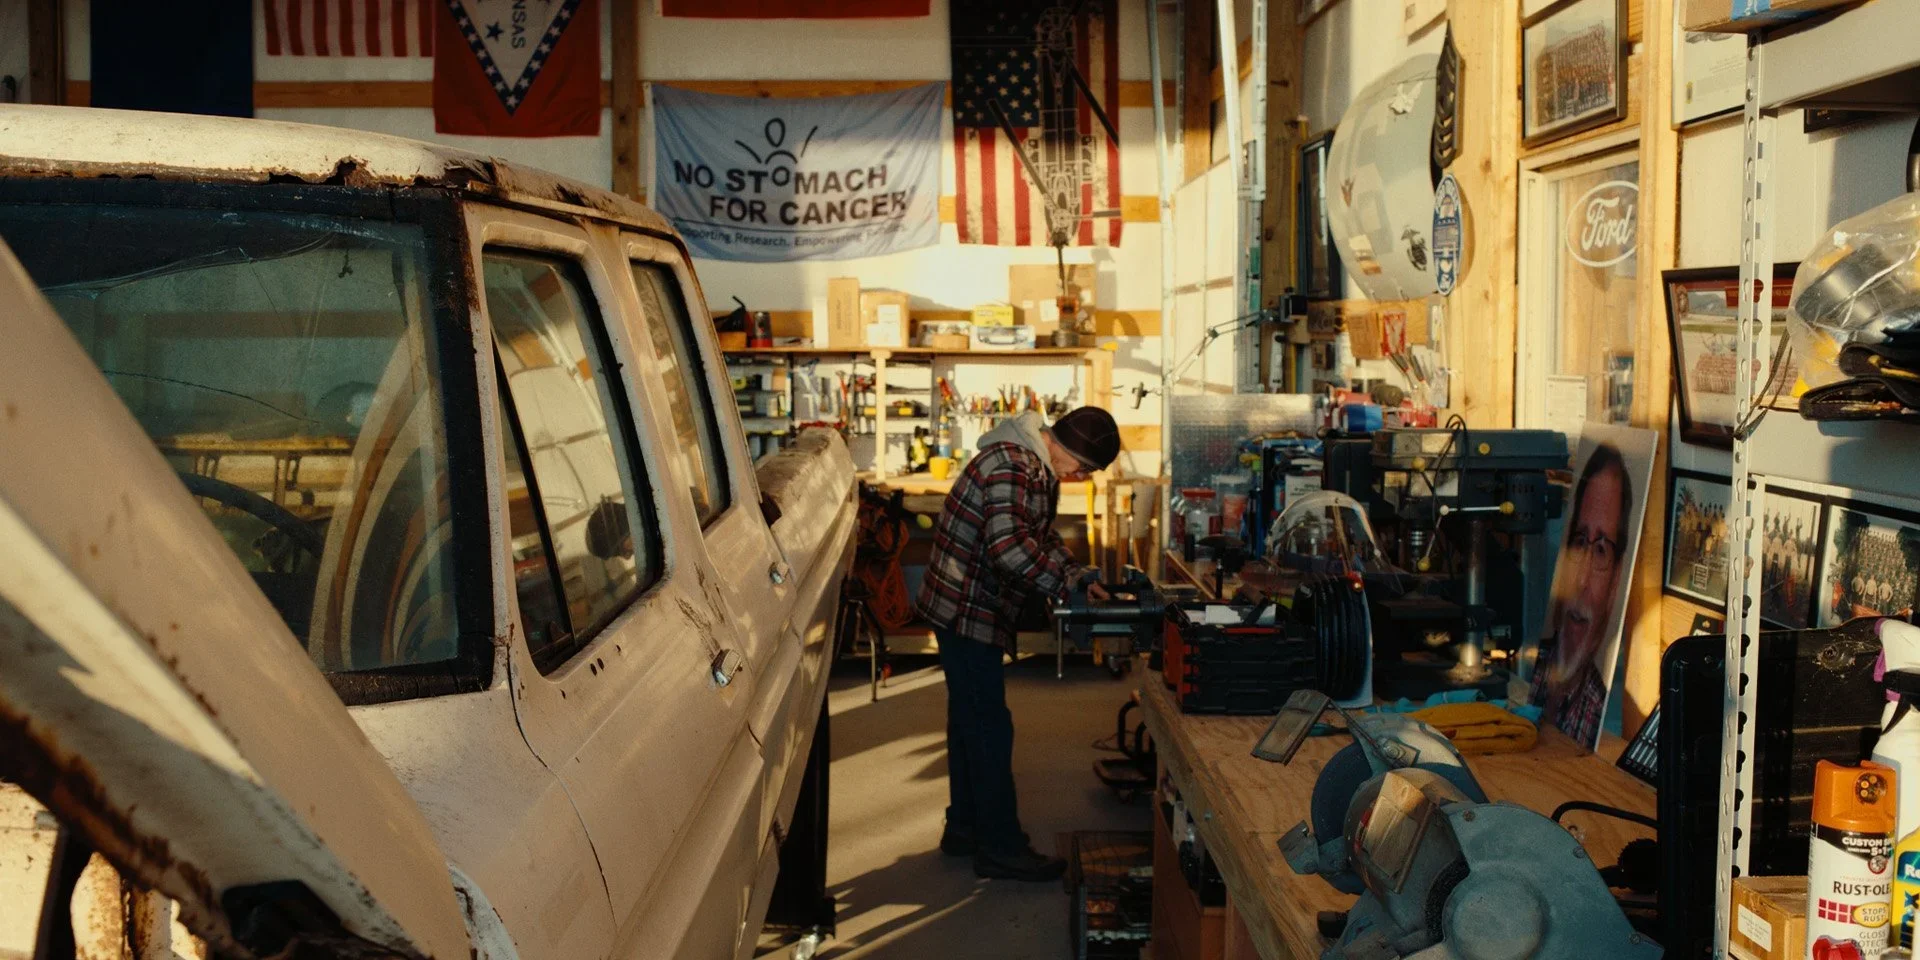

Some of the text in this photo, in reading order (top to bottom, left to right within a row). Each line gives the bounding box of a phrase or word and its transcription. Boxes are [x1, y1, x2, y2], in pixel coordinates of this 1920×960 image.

[673, 159, 888, 195] NO STOMACH
[709, 190, 907, 226] FOR CANCER
[1581, 195, 1634, 251] Ford
[1842, 837, 1882, 847] CUSTOM
[1862, 907, 1886, 916] STOPS
[1859, 931, 1886, 940] GLOSS
